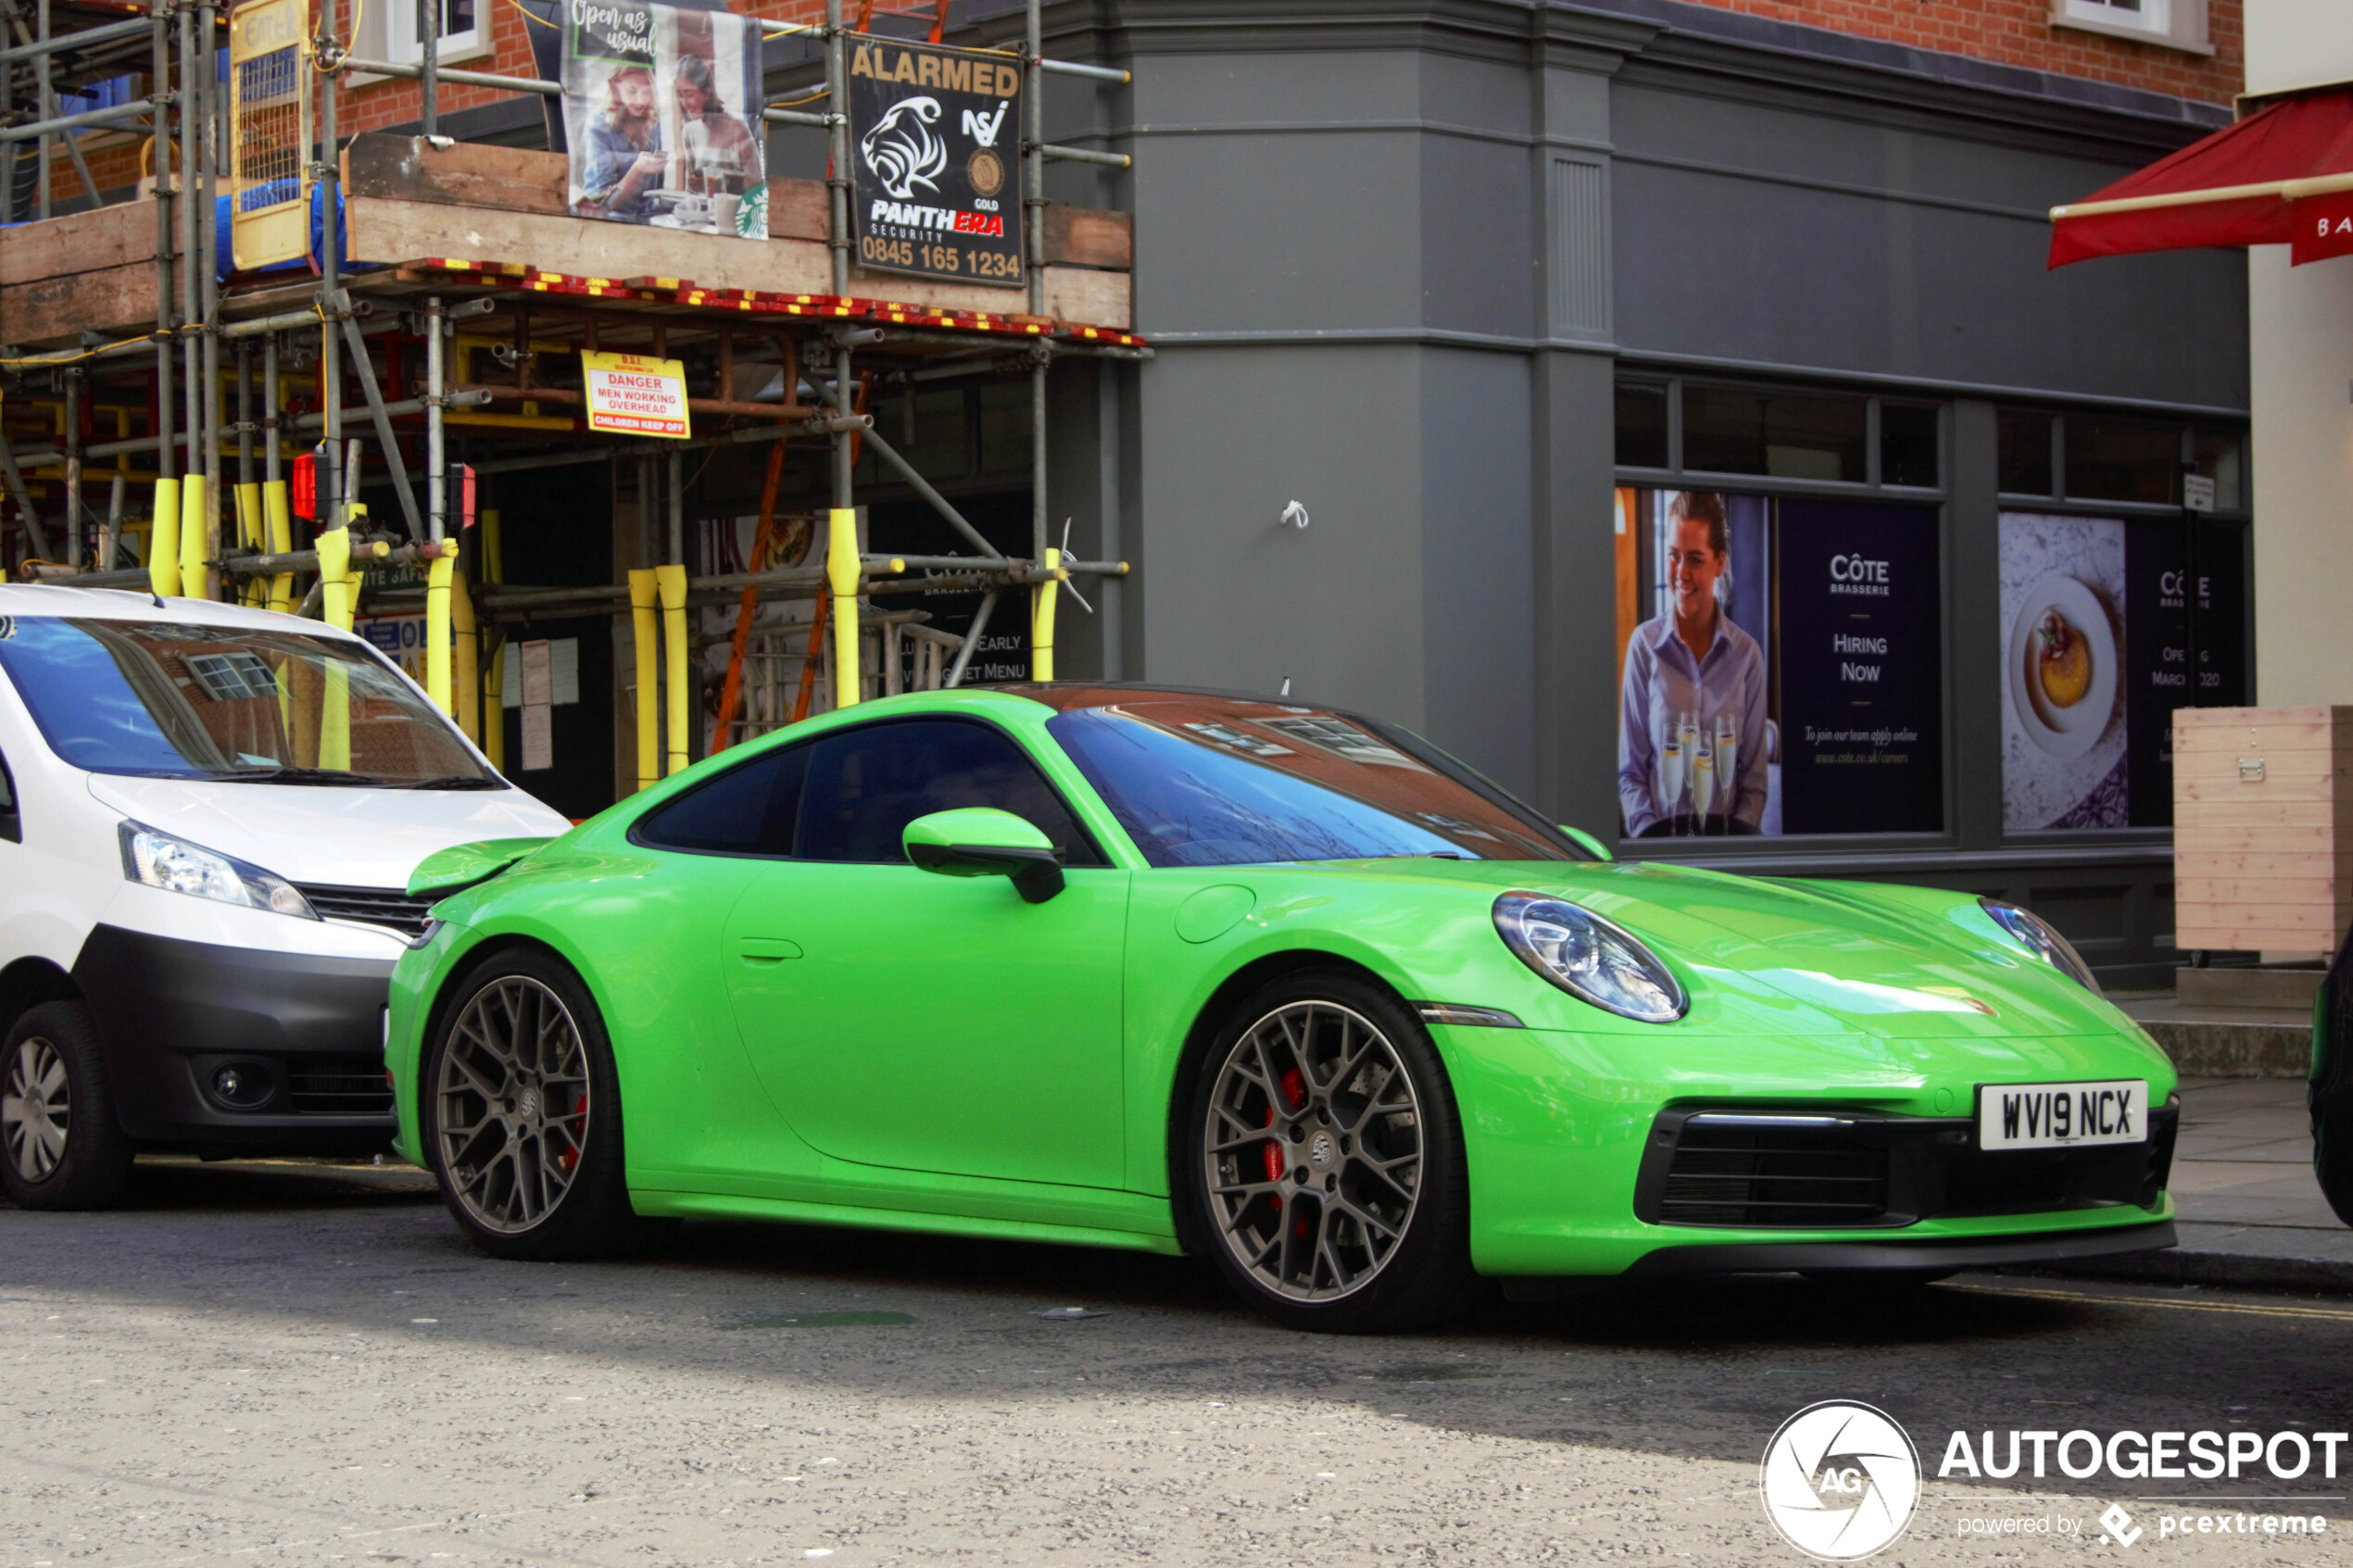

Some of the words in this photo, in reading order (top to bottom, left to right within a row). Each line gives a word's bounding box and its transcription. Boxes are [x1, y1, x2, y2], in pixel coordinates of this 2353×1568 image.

[572, 0, 622, 32] Open
[624, 11, 648, 33] as
[607, 22, 659, 57] usual
[850, 44, 1019, 98] ALARMED
[974, 197, 1000, 212] GOLD
[870, 199, 1004, 238] PANTHERA
[871, 222, 943, 244] SECURITY
[862, 235, 913, 266] 0845
[920, 244, 960, 271] 165
[967, 250, 1020, 278] 1234
[609, 373, 662, 389] DANGER
[598, 388, 621, 399] MEN
[624, 390, 676, 404] WORKING
[609, 400, 666, 414] OVERHEAD
[595, 415, 639, 428] CHILDREN
[641, 420, 664, 431] KEEP
[666, 422, 684, 432] OFF
[1831, 553, 1890, 583] CÔTE
[364, 571, 385, 586] ITE
[1830, 583, 1890, 596] BRASSERIE
[1833, 633, 1888, 654] HIRING
[985, 663, 1026, 679] MENU
[1842, 662, 1881, 682] NOW
[2152, 671, 2185, 685] MARC
[1806, 726, 1815, 741] To
[1815, 727, 1832, 746] join
[1834, 730, 1848, 741] our
[1850, 728, 1869, 741] team
[1870, 727, 1892, 746] apply
[1894, 727, 1918, 741] online
[2003, 1092, 2070, 1139] WV19
[2081, 1089, 2131, 1135] NCX
